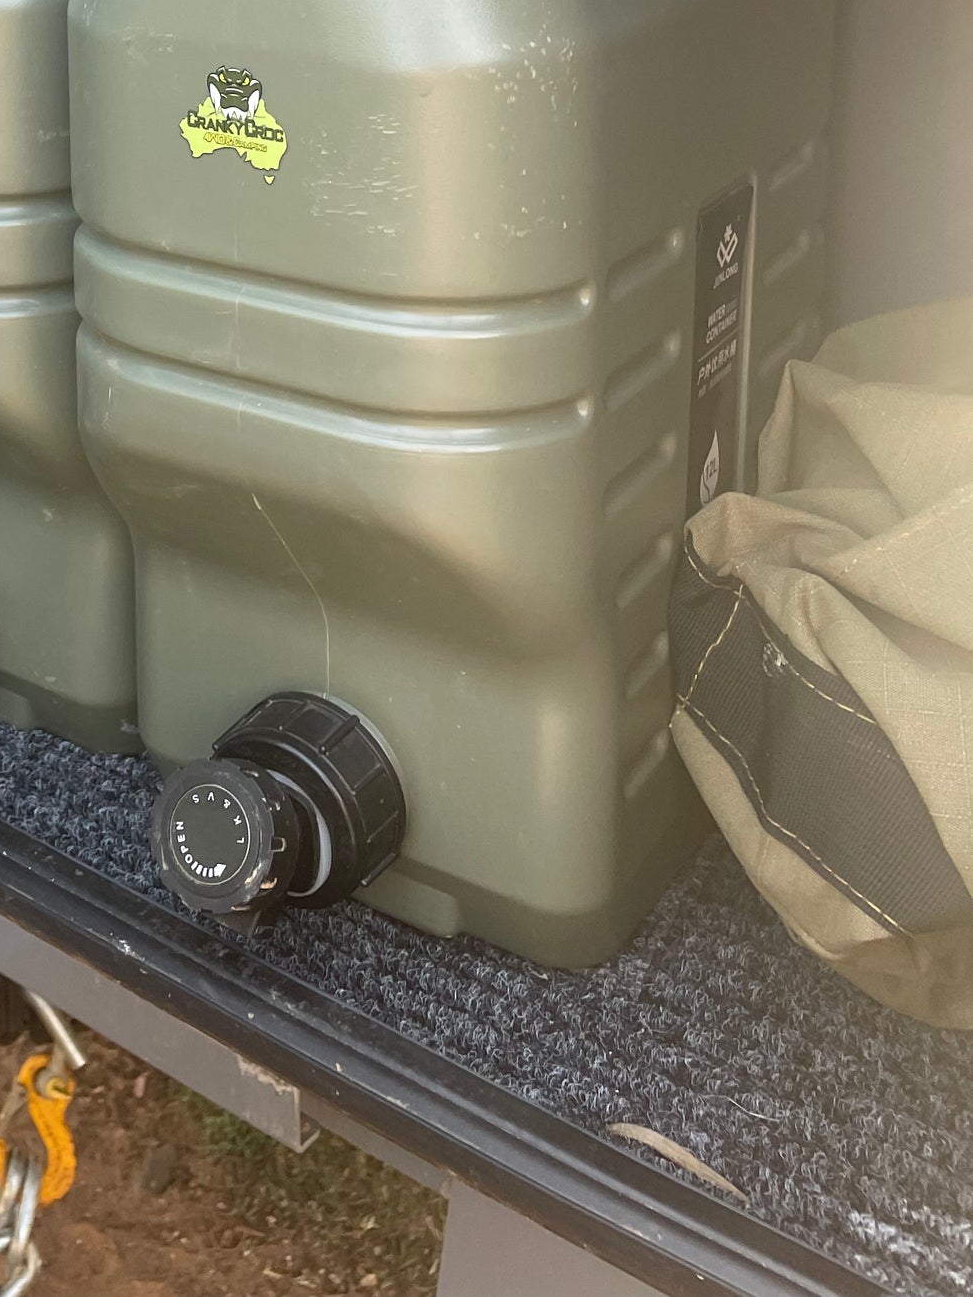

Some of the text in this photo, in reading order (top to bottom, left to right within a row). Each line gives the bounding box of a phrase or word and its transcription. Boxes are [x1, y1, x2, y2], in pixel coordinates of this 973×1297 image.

[187, 109, 284, 142] CRANKY CROC
[175, 821, 193, 864] OPEN
